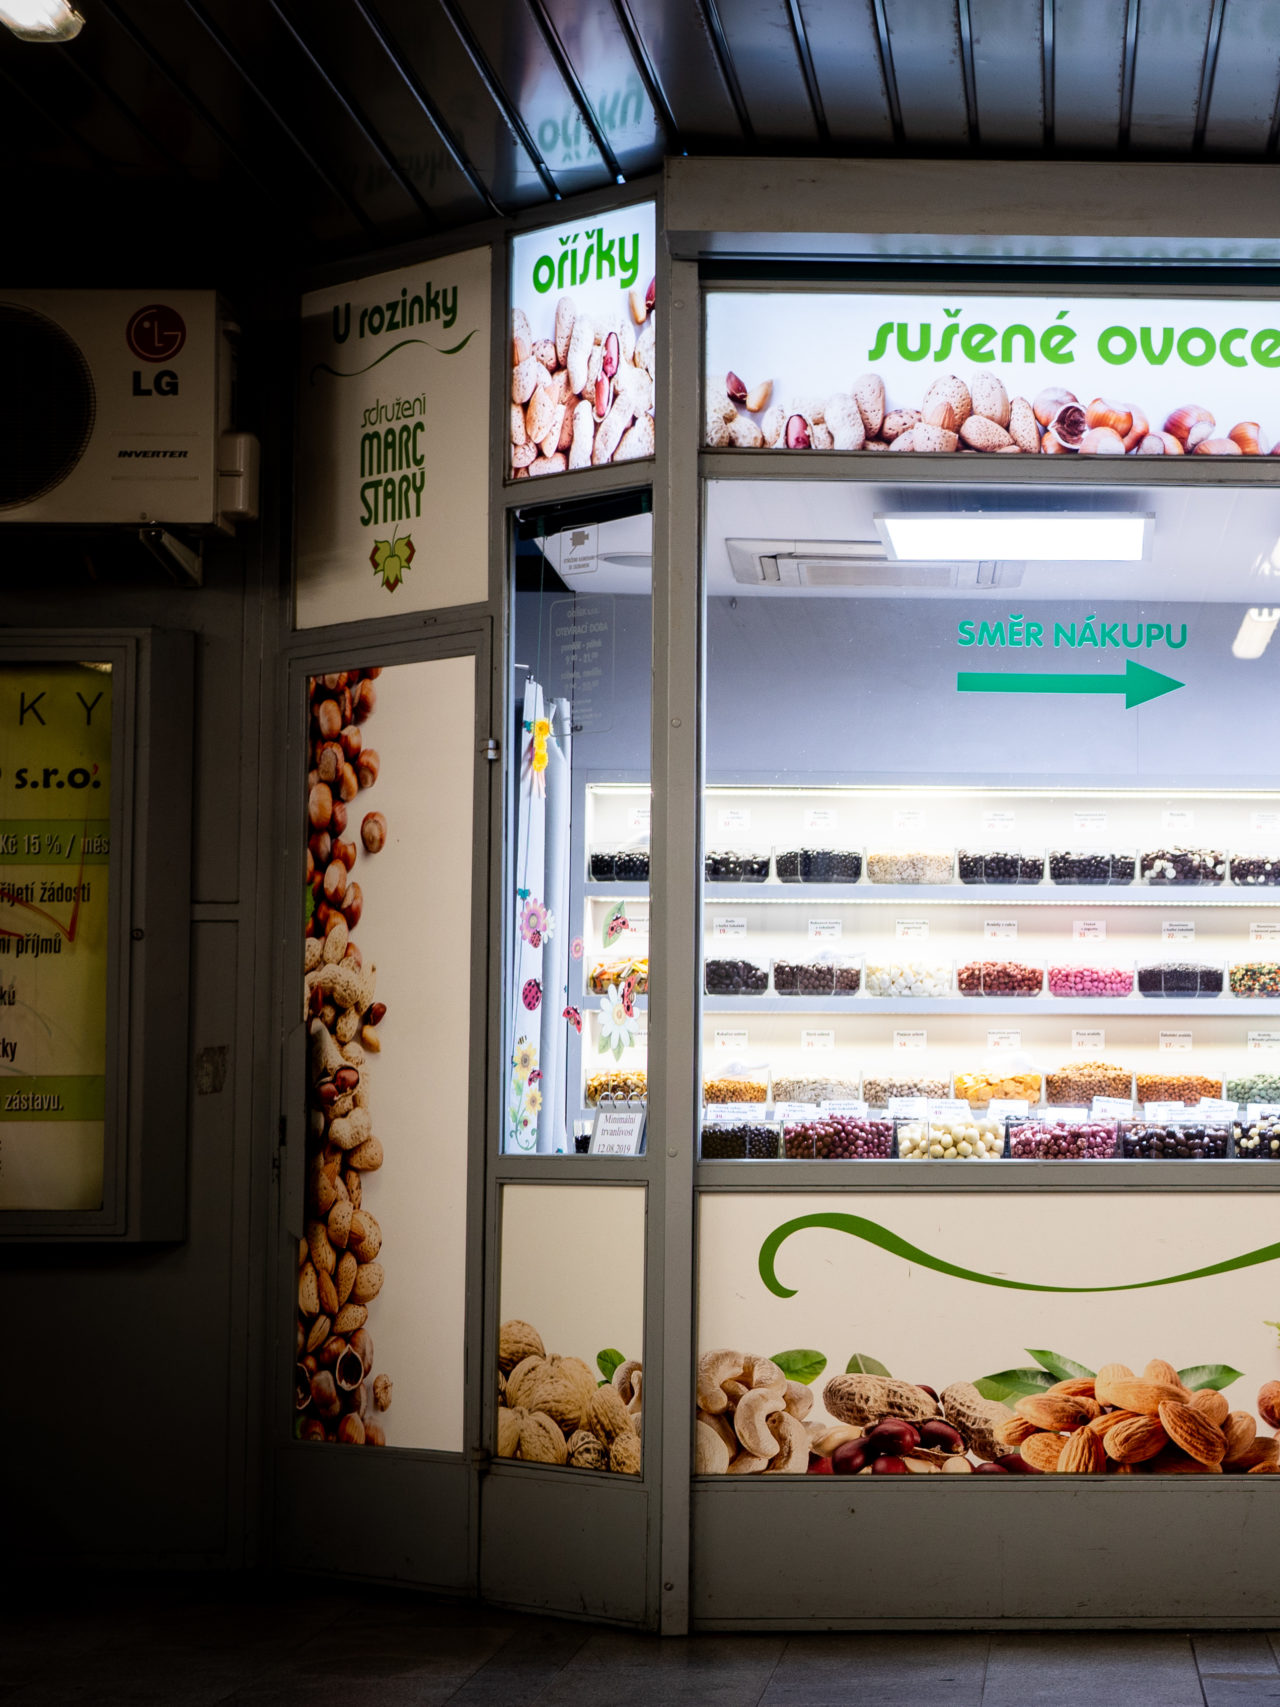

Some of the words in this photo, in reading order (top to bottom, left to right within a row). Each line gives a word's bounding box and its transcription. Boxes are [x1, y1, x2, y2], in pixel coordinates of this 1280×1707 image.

[533, 227, 639, 294] oříšky
[333, 302, 350, 344] U
[359, 281, 458, 338] rozinky
[868, 308, 1077, 364] sušené
[132, 370, 179, 396] LG
[361, 393, 426, 428] sdružení
[118, 450, 188, 458] INVERTER
[360, 421, 425, 478] MARC
[360, 467, 426, 527] STARÝ
[957, 614, 1044, 647] SMĚR
[1054, 614, 1188, 649] NÁKUPU
[24, 834, 41, 854] 15
[45, 834, 61, 854] %
[16, 933, 61, 958] příjmů
[0, 1037, 17, 1062] ky
